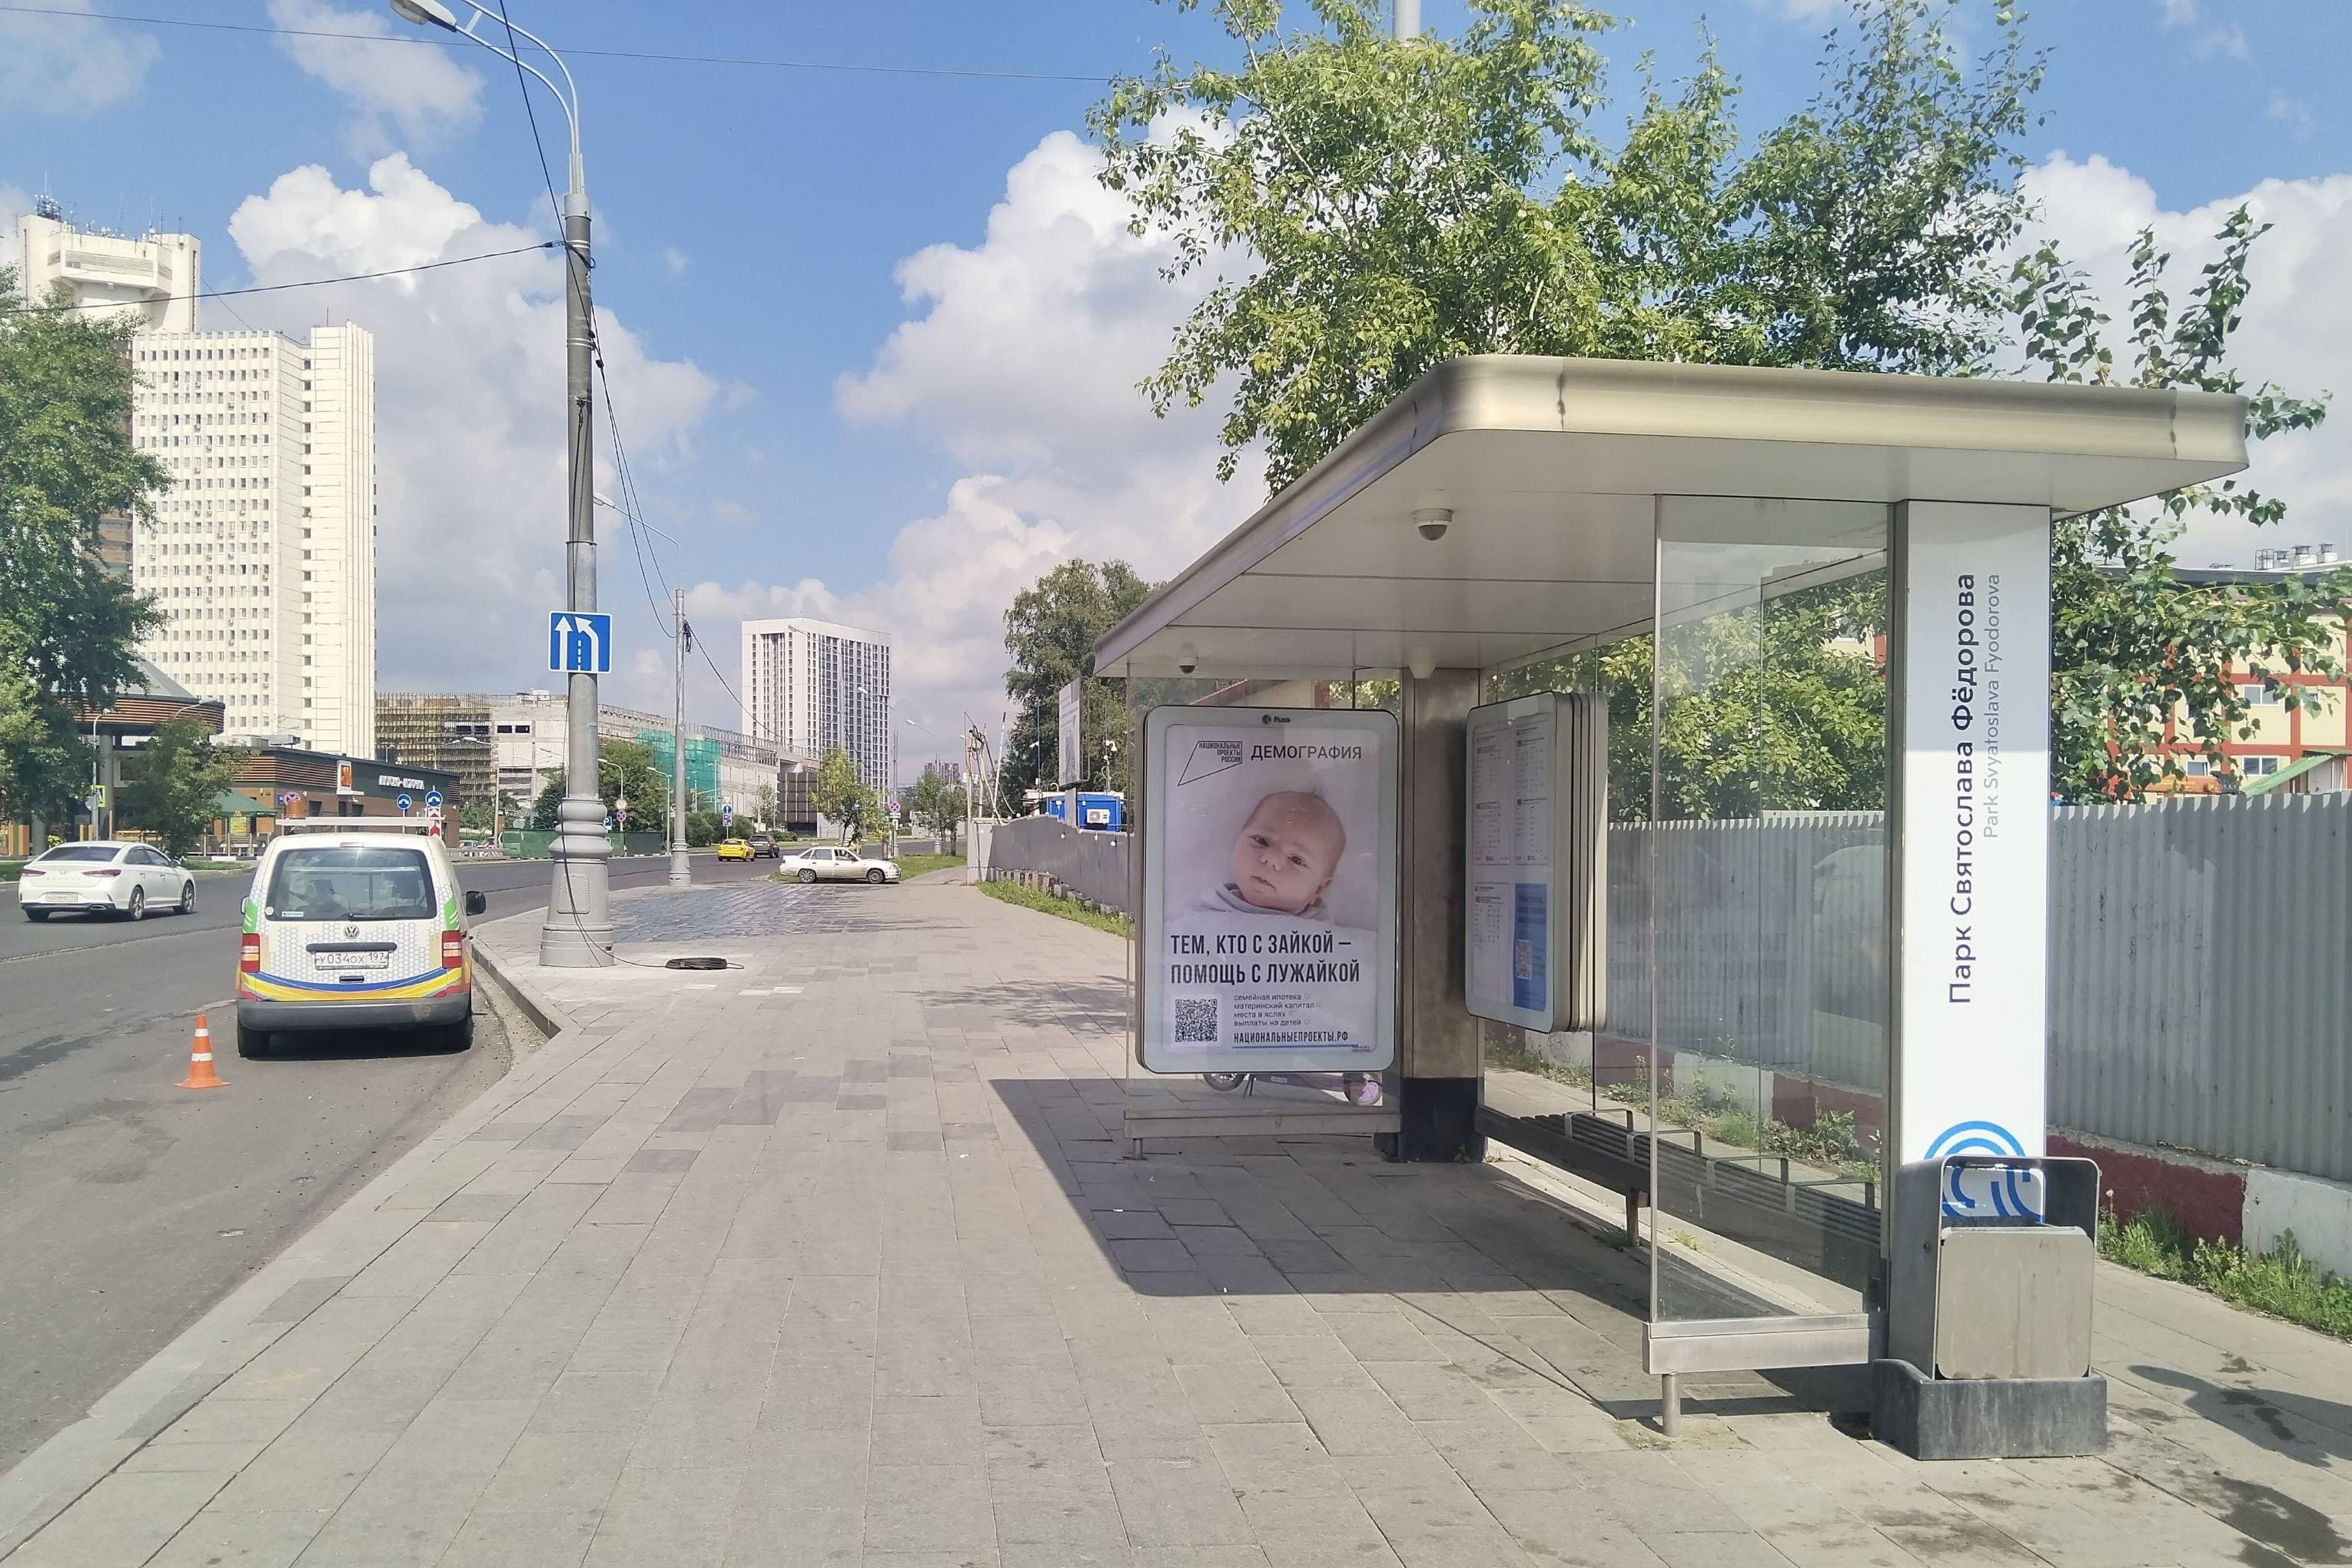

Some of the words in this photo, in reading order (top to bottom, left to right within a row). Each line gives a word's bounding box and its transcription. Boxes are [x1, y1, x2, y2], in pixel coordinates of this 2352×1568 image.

[1984, 574, 2002, 673] Fyodorova
[1951, 574, 1979, 731] Фёдорова
[1251, 745, 1362, 761] ДЕМОГРАФИЯ
[1983, 680, 2002, 789] Svyatoslava
[1950, 742, 1973, 915] Святослава
[1983, 795, 1998, 838] Park
[368, 952, 385, 961] 197
[1170, 935, 1211, 956] ТЕМ,
[1216, 935, 1247, 954] КТО
[1253, 934, 1262, 954] С
[1268, 930, 1334, 954] ЗАЙКОЙ
[1948, 925, 1976, 1003] Парк
[1171, 964, 1246, 985] ПОМОЩЬ
[1251, 964, 1261, 983] С
[1266, 959, 1360, 983] ЛУЖАЙКОЙ
[1234, 1031, 1348, 1044] НАЦИОНАЛЬНЫЕПРОЕКТЫ.РФ
